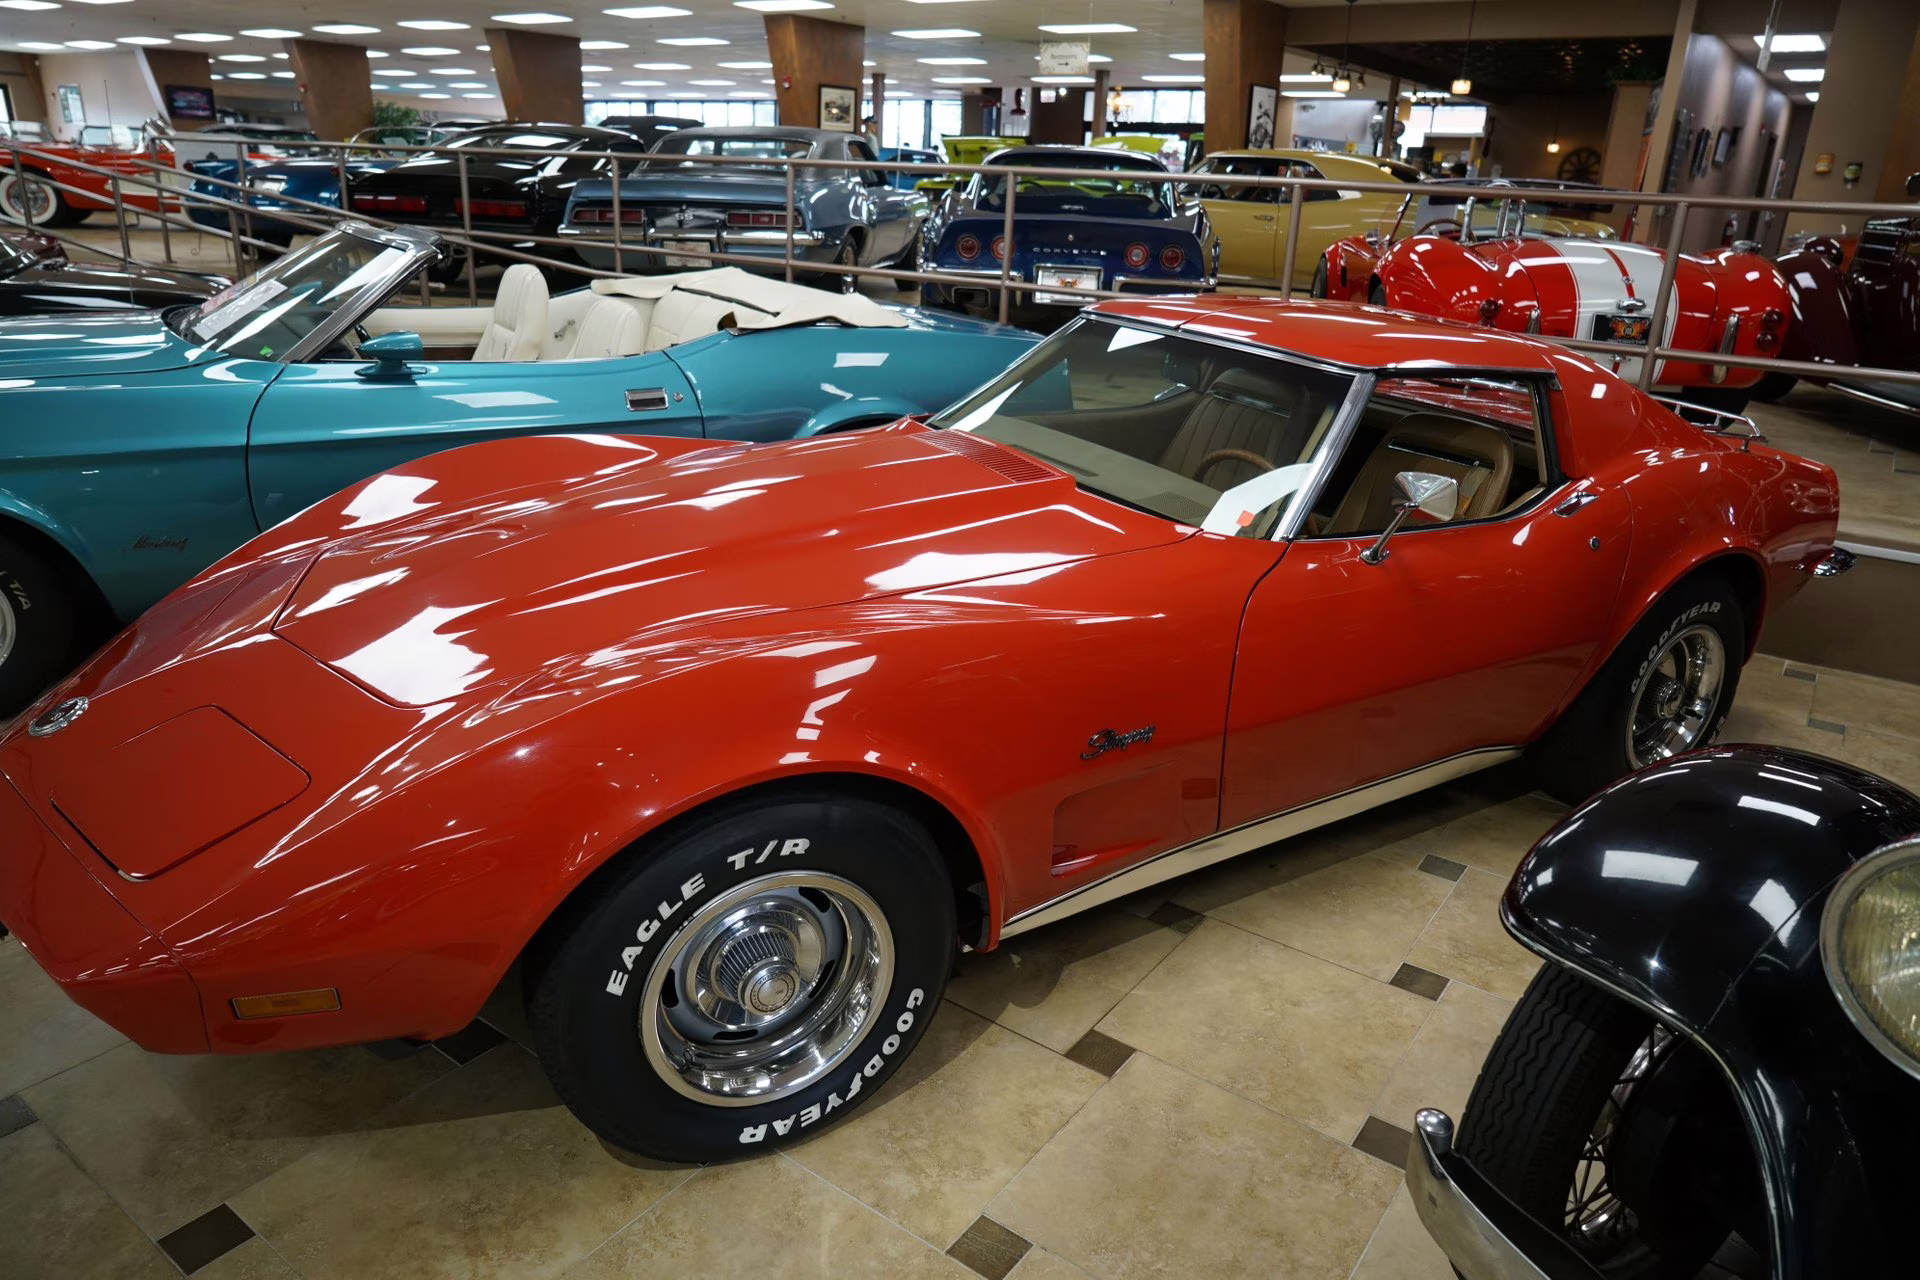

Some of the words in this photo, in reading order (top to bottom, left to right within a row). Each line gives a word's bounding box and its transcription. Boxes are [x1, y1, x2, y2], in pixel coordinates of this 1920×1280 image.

[1033, 247, 1107, 256] CORVETTE
[9, 579, 32, 611] T/A
[1631, 601, 1722, 694] GOODYEAR
[605, 872, 707, 998] EAGLE
[727, 837, 811, 871] T/R
[738, 987, 925, 1145] GOODYEAR
